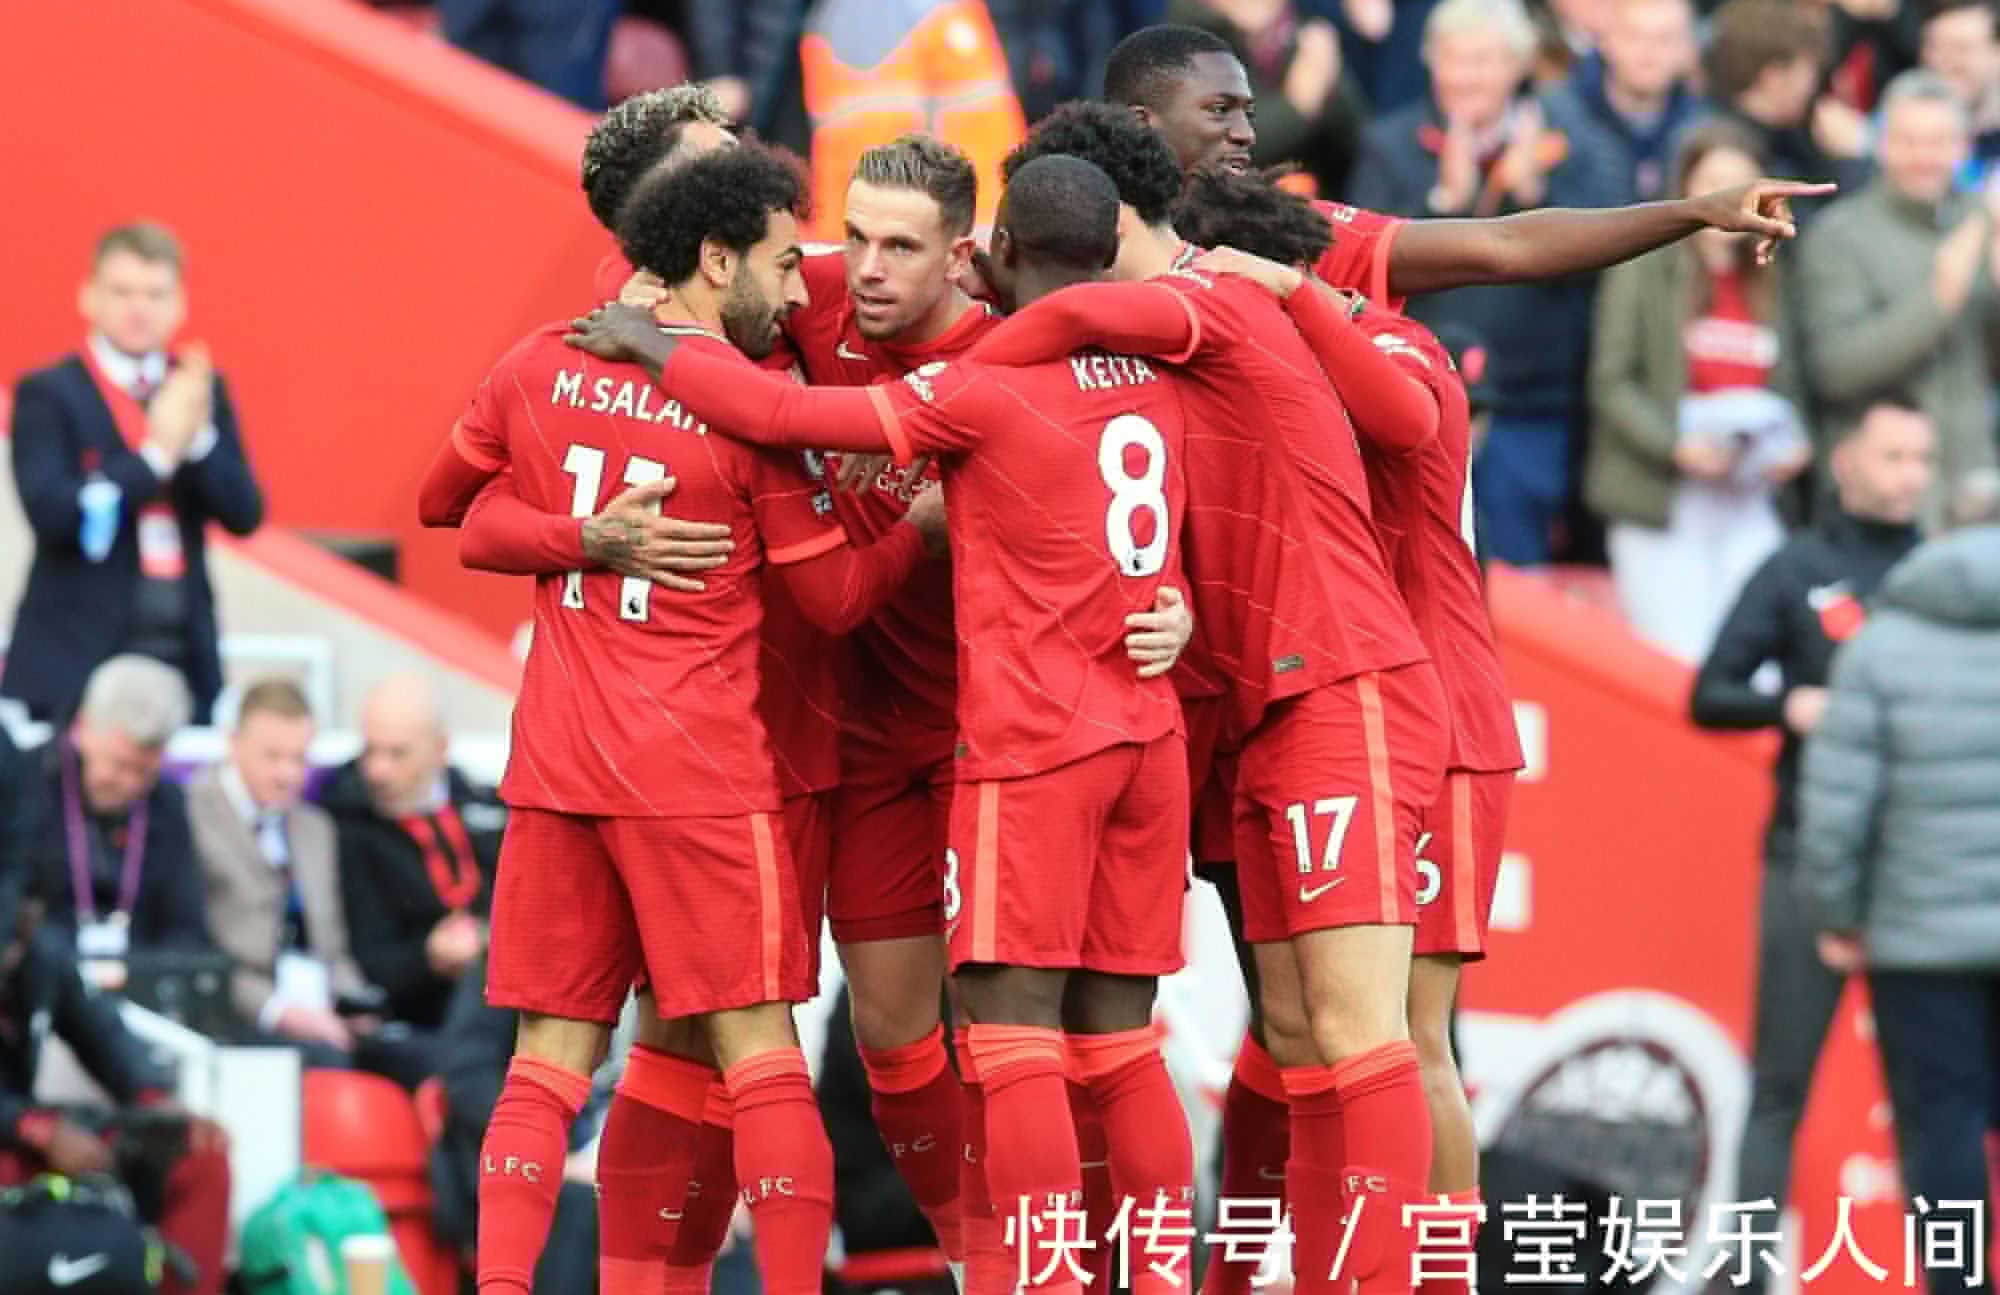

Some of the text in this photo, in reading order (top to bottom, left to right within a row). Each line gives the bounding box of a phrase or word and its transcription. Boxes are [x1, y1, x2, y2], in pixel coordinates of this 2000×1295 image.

[1071, 355, 1158, 392] KEITA
[1099, 414, 1168, 577] 8
[1286, 795, 1359, 874] 17
